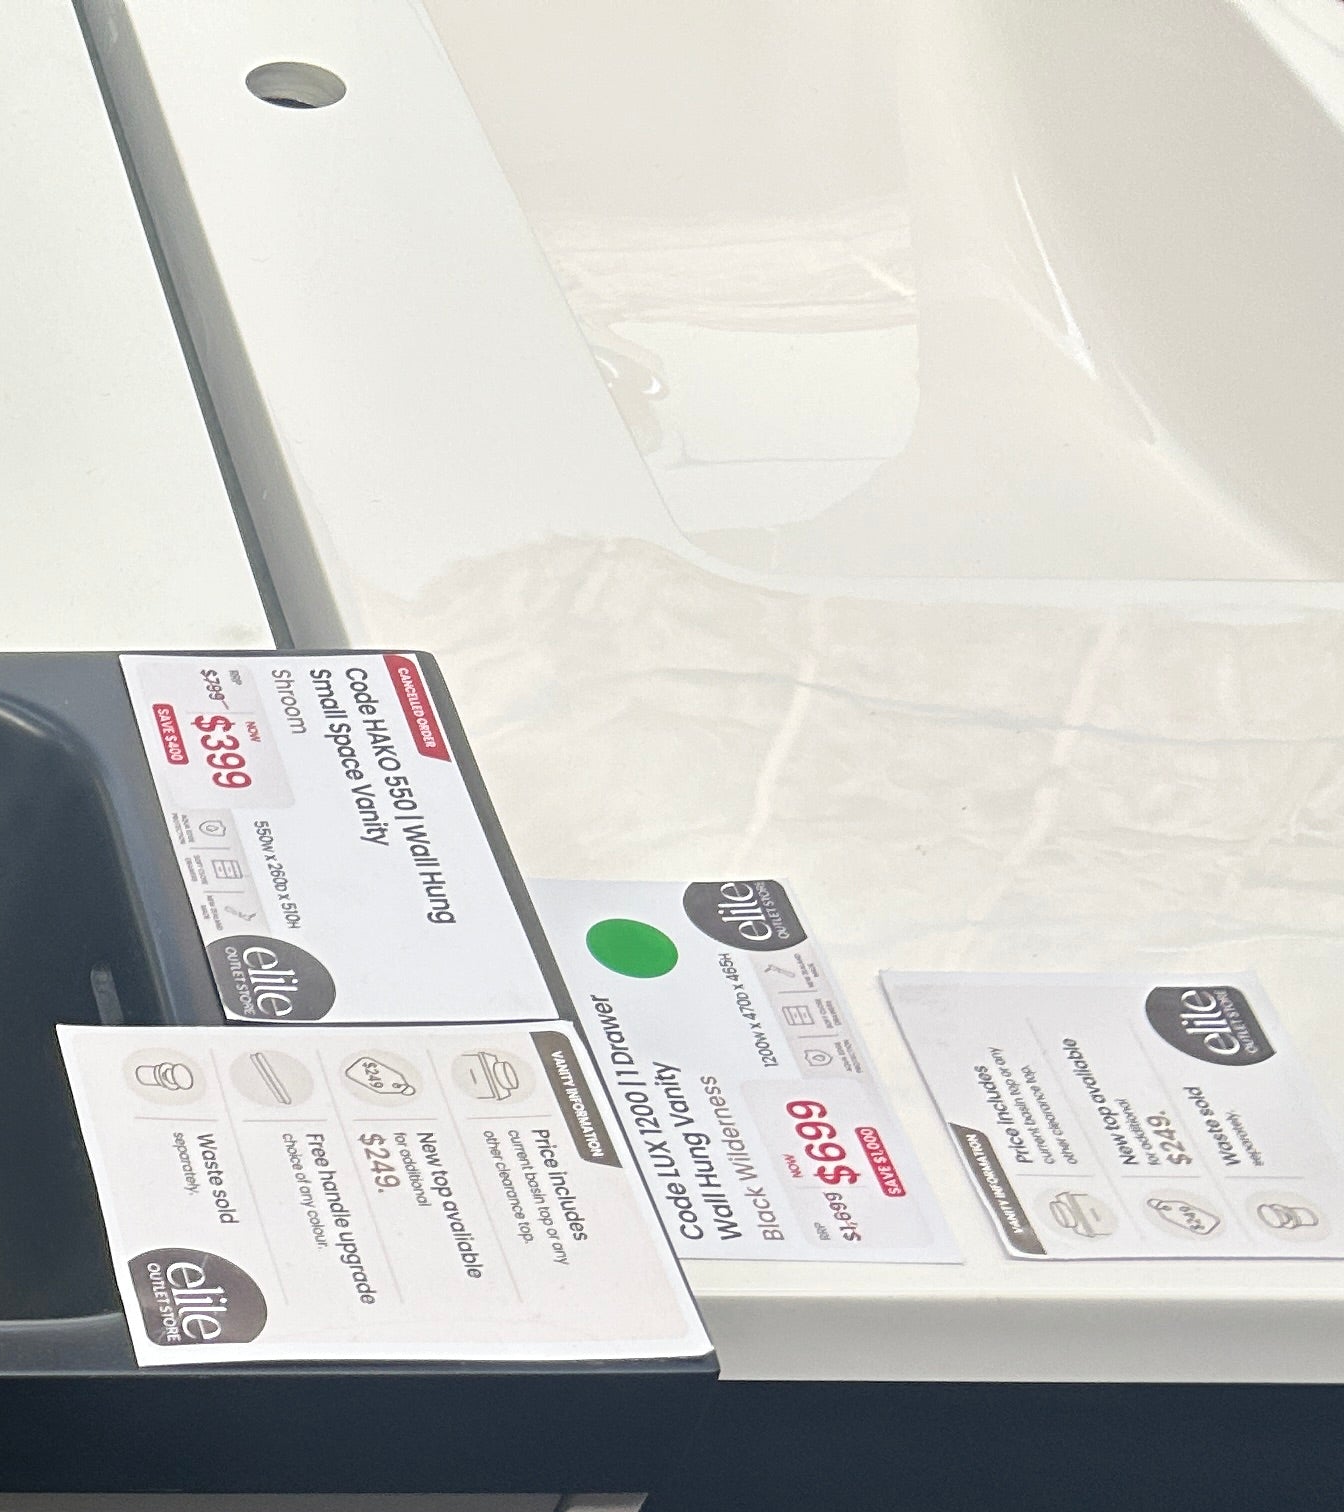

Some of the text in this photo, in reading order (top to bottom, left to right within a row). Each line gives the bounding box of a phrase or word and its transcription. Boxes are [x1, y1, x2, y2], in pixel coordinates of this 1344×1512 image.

[270, 669, 307, 734] Shroom
[344, 667, 379, 715] Code
[397, 666, 436, 747] CANCELLED ORDER
[156, 708, 183, 760] SAVE $400
[190, 714, 252, 788] $399
[245, 720, 261, 742] NOW
[309, 668, 389, 846] Small Space Vanity
[361, 718, 401, 771] HAKO
[383, 775, 417, 810] 550
[401, 824, 440, 867] Wall
[418, 871, 456, 924] Hung
[765, 907, 790, 939] OUTLET
[224, 946, 256, 1015] OUTLET STORE
[589, 993, 634, 1065] Drawer
[361, 1061, 384, 1089] $249
[550, 1050, 604, 1157] VANITY INFORMATION
[1004, 1078, 1021, 1095] top
[624, 1091, 662, 1135] 1200
[785, 1100, 861, 1185] $699
[973, 1065, 1033, 1163] Price includes
[1097, 1105, 1120, 1131] top
[1145, 1110, 1193, 1165] $249.
[1182, 1086, 1241, 1166] Waste sold
[171, 1131, 200, 1195] separately.
[196, 1133, 239, 1223] Waste sold
[281, 1132, 303, 1170] choice
[356, 1132, 401, 1193] $249.
[398, 1148, 432, 1206] additional
[416, 1132, 442, 1167] New
[429, 1169, 452, 1197] top
[643, 1140, 680, 1177] LUX
[651, 1061, 742, 1240] Wall Hung Vanity
[699, 1075, 785, 1241] Black Wilderness
[783, 1153, 802, 1178] NOW
[859, 1127, 901, 1194] SAVE $1,000
[1110, 1133, 1139, 1165] New
[298, 1185, 315, 1208] any
[482, 1130, 534, 1244] other clearance top.
[507, 1129, 534, 1170] current
[523, 1172, 546, 1204] basin
[537, 1206, 553, 1226] top
[551, 1242, 569, 1265] any
[531, 1129, 588, 1241] Price includes
[665, 1182, 704, 1240] Code
[965, 1133, 1024, 1233] VANITY INFORMATION
[305, 1133, 377, 1304] Free handle upgrade
[306, 1209, 328, 1249] colour.
[146, 1262, 181, 1342] OUTLET STORE
